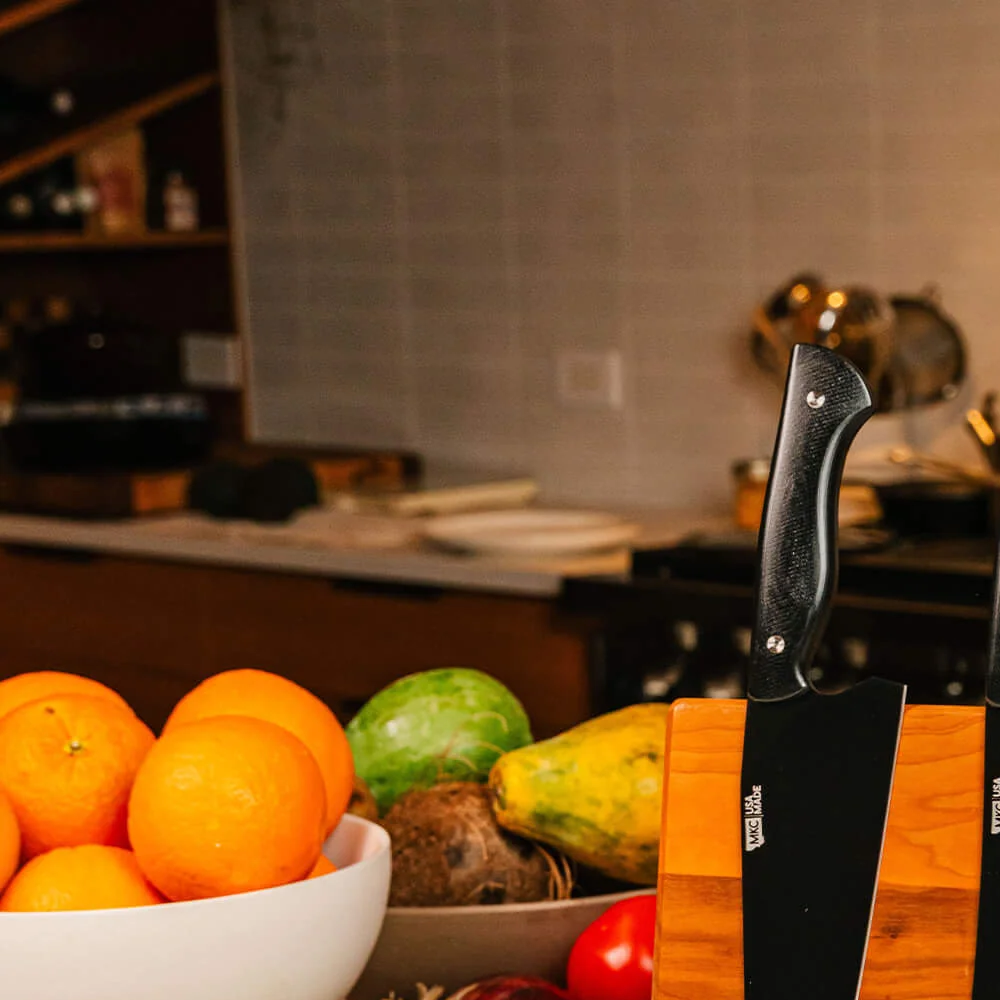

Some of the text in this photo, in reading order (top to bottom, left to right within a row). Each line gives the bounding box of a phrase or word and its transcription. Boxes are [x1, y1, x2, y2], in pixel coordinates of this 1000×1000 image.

[992, 777, 1000, 797] USA
[744, 795, 753, 814] USA
[752, 785, 761, 814] MADE
[749, 820, 759, 844] MKC
